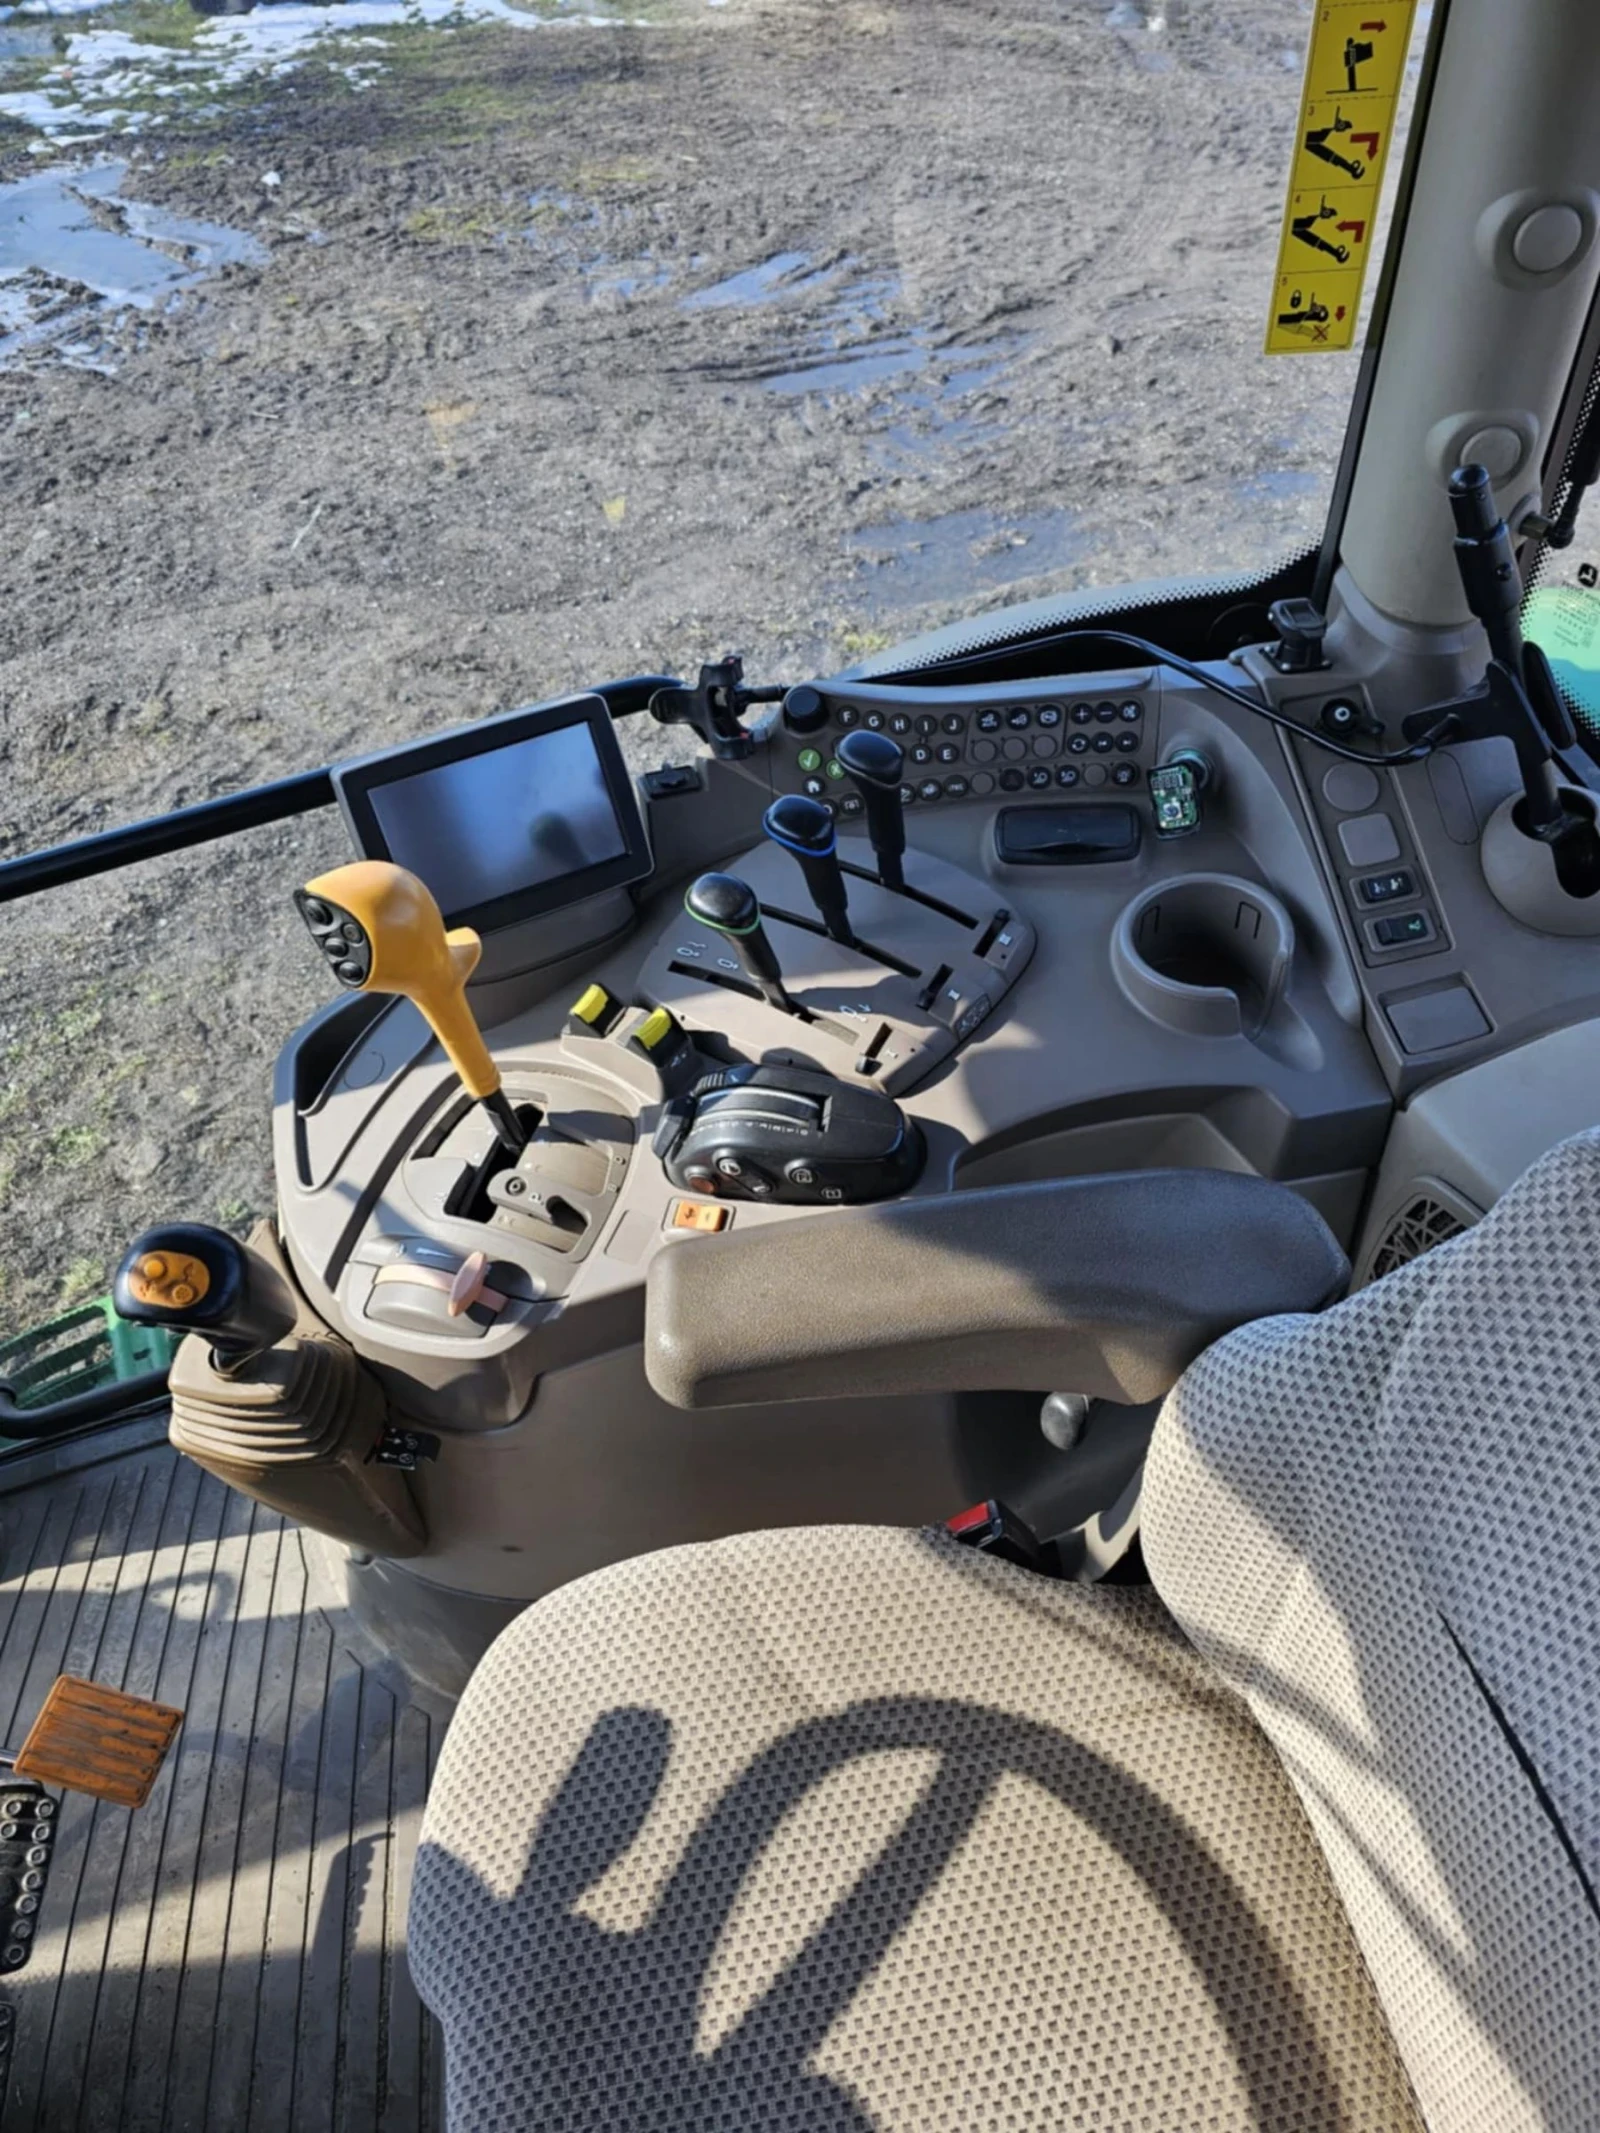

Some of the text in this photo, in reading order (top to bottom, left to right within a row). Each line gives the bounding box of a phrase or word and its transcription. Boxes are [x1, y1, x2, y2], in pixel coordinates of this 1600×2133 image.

[1307, 105, 1315, 116] 3
[843, 711, 851, 722] F
[868, 716, 879, 727] G
[894, 719, 905, 731] H
[949, 719, 957, 730] J
[916, 748, 952, 760] D E
